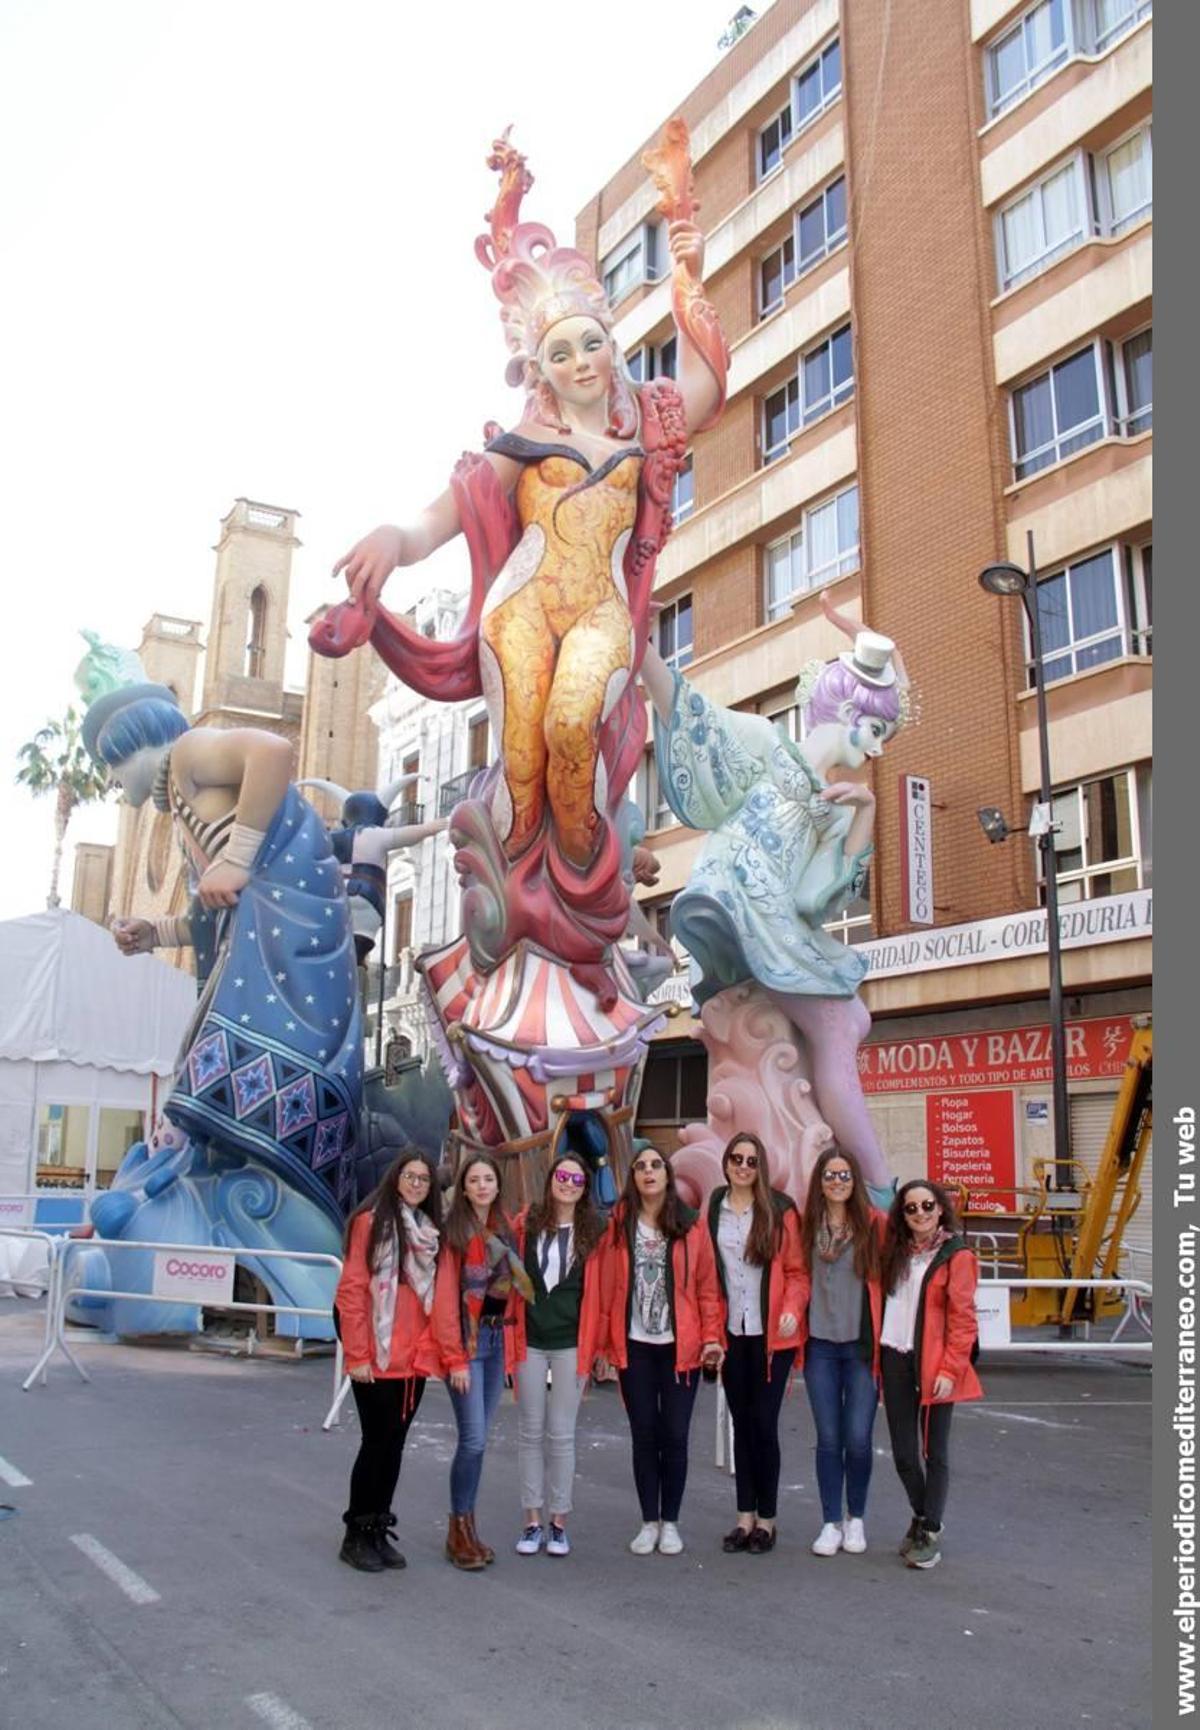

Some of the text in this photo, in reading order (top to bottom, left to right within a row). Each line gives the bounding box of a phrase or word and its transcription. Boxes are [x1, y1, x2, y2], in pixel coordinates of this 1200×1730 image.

[914, 803, 928, 919] CENTECO
[923, 929, 985, 961] SOCIAL
[877, 1040, 954, 1074] MODA
[961, 1037, 979, 1068] Y
[876, 1077, 947, 1091] COMPLEMENTOS
[949, 1075, 957, 1085] Y
[959, 1073, 985, 1084] TODO
[988, 1071, 1009, 1082] TIPO
[1012, 1069, 1027, 1080] DE
[1029, 1064, 1091, 1079] ARTILOS
[942, 1123, 978, 1133] Bolsos
[942, 1136, 985, 1147] Zapatos
[166, 1258, 227, 1279] Cocoro
